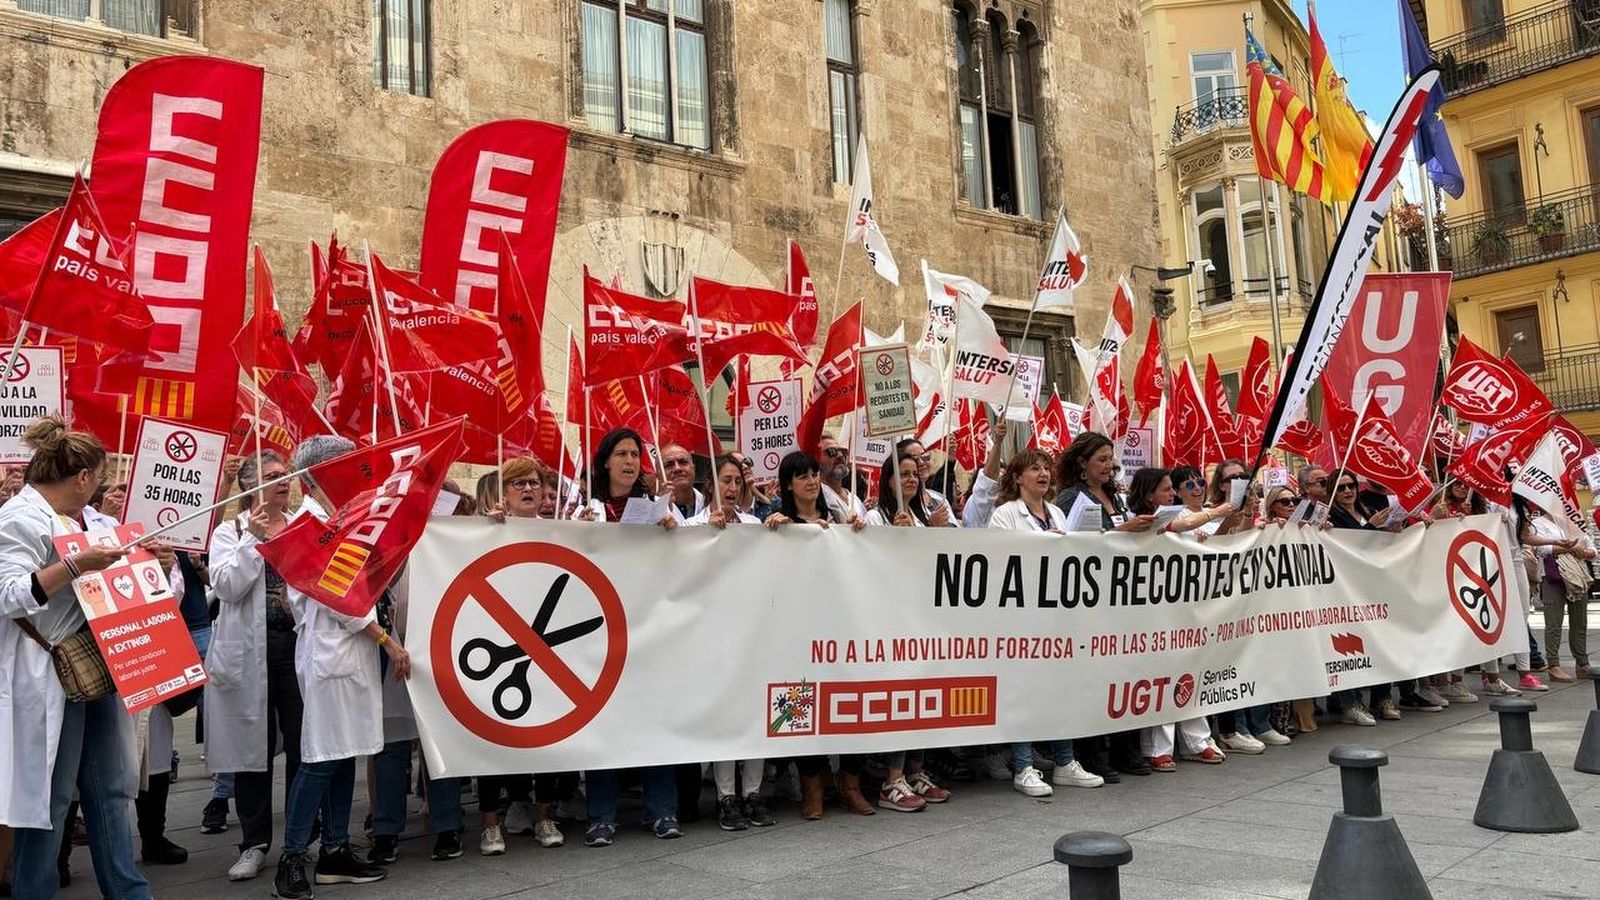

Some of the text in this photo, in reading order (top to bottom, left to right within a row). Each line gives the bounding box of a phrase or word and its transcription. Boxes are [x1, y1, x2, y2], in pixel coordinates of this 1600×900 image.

[54, 254, 99, 281] país
[591, 330, 620, 346] país
[11, 386, 20, 399] A
[22, 386, 37, 399] LA
[870, 391, 911, 407] RECORTES EN
[1457, 364, 1514, 412] UGT
[754, 415, 789, 431] PER LES
[751, 437, 763, 451] 35
[153, 463, 202, 485] POR LAS
[1518, 474, 1552, 496] SALUT
[144, 485, 202, 507] 35 HORAS
[934, 553, 989, 608] NO
[998, 554, 1025, 608] A
[1037, 554, 1101, 608] LOS
[1110, 551, 1239, 607] RECORTES
[1240, 546, 1264, 595] EN
[100, 611, 177, 641] PERSONAL LABORAL
[107, 633, 152, 656] A EXTINGIR
[811, 639, 838, 663] NO
[845, 639, 858, 662] A
[864, 639, 885, 662] LA
[892, 637, 989, 661] MOVILIDAD
[995, 637, 1073, 659] FORZOSA
[1091, 635, 1118, 657] POR
[1122, 633, 1147, 654] LAS
[1151, 631, 1166, 652] 35
[1170, 628, 1208, 650] HORAS
[1216, 623, 1235, 644] POR
[1107, 665, 1237, 720] UGT Serveis
[1199, 681, 1256, 707] Públics PV
[830, 688, 943, 724] CCOO
